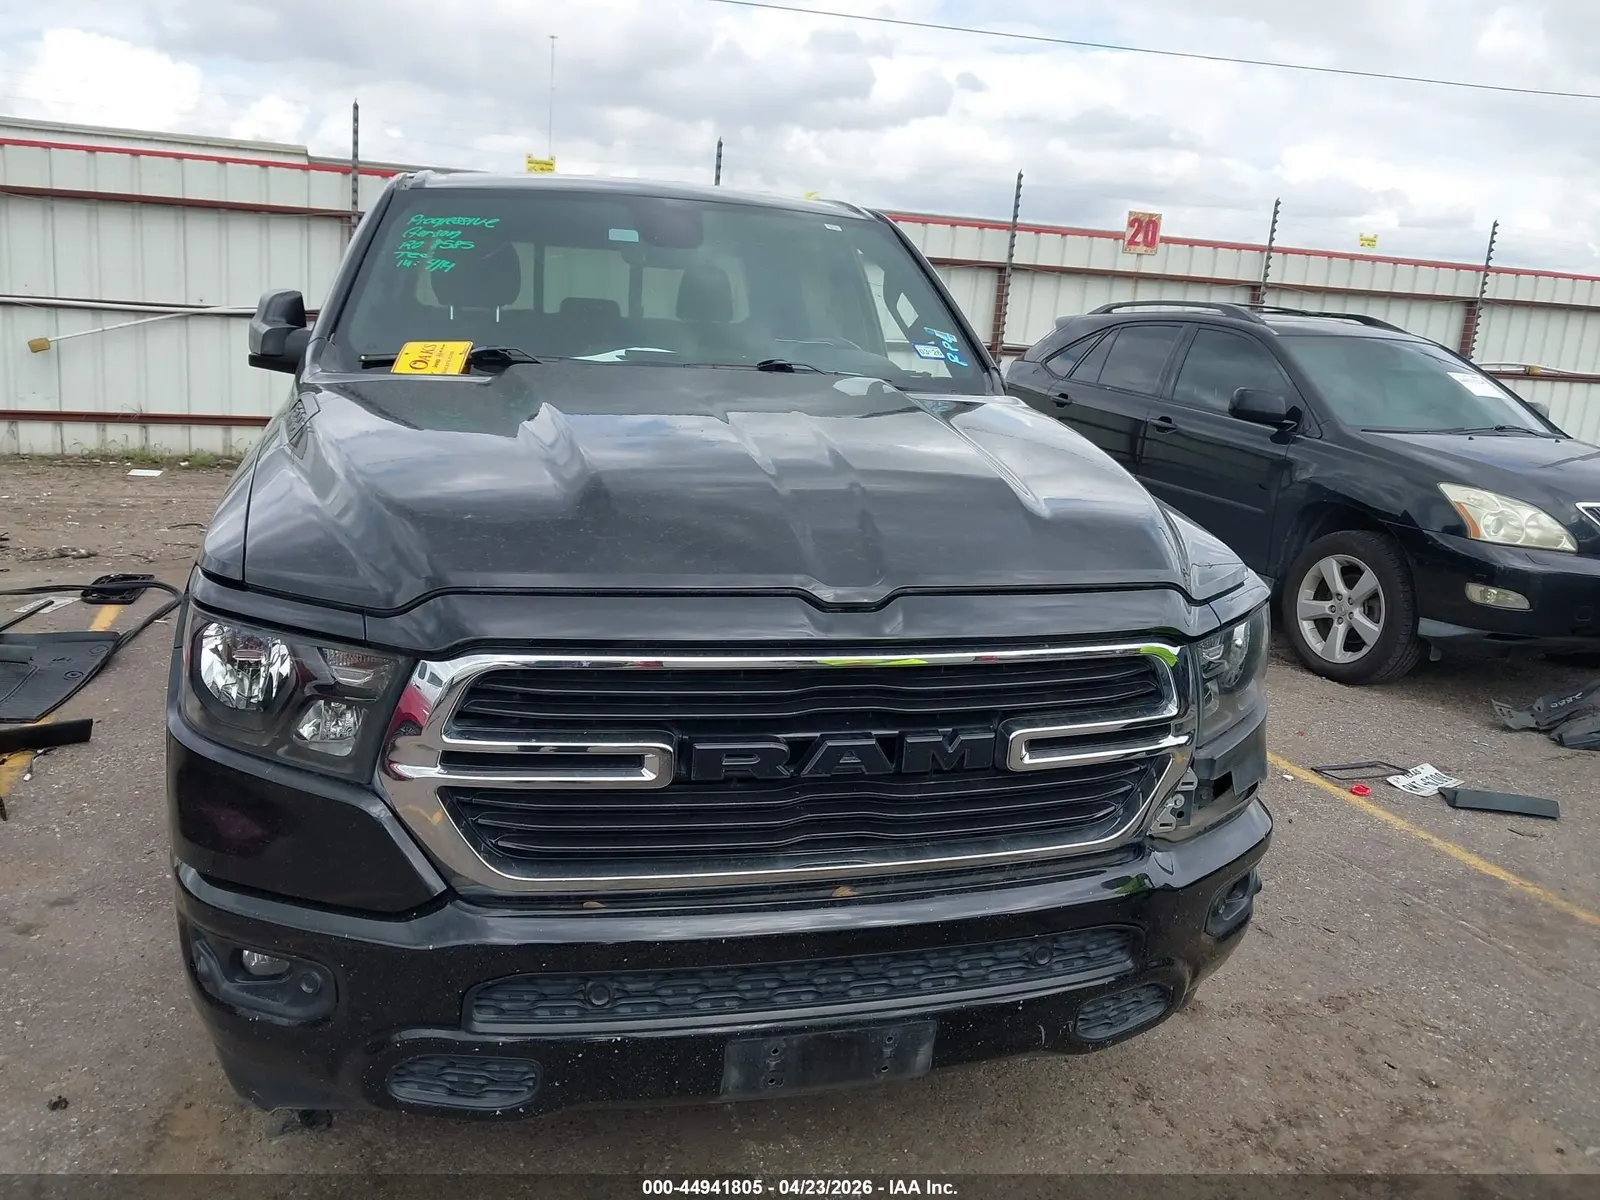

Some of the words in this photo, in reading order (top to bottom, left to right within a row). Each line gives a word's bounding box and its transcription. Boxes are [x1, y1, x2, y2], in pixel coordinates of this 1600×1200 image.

[407, 214, 500, 228] Progressive
[1128, 216, 1158, 248] 20
[408, 343, 437, 370] OAKS
[691, 727, 996, 781] RAM
